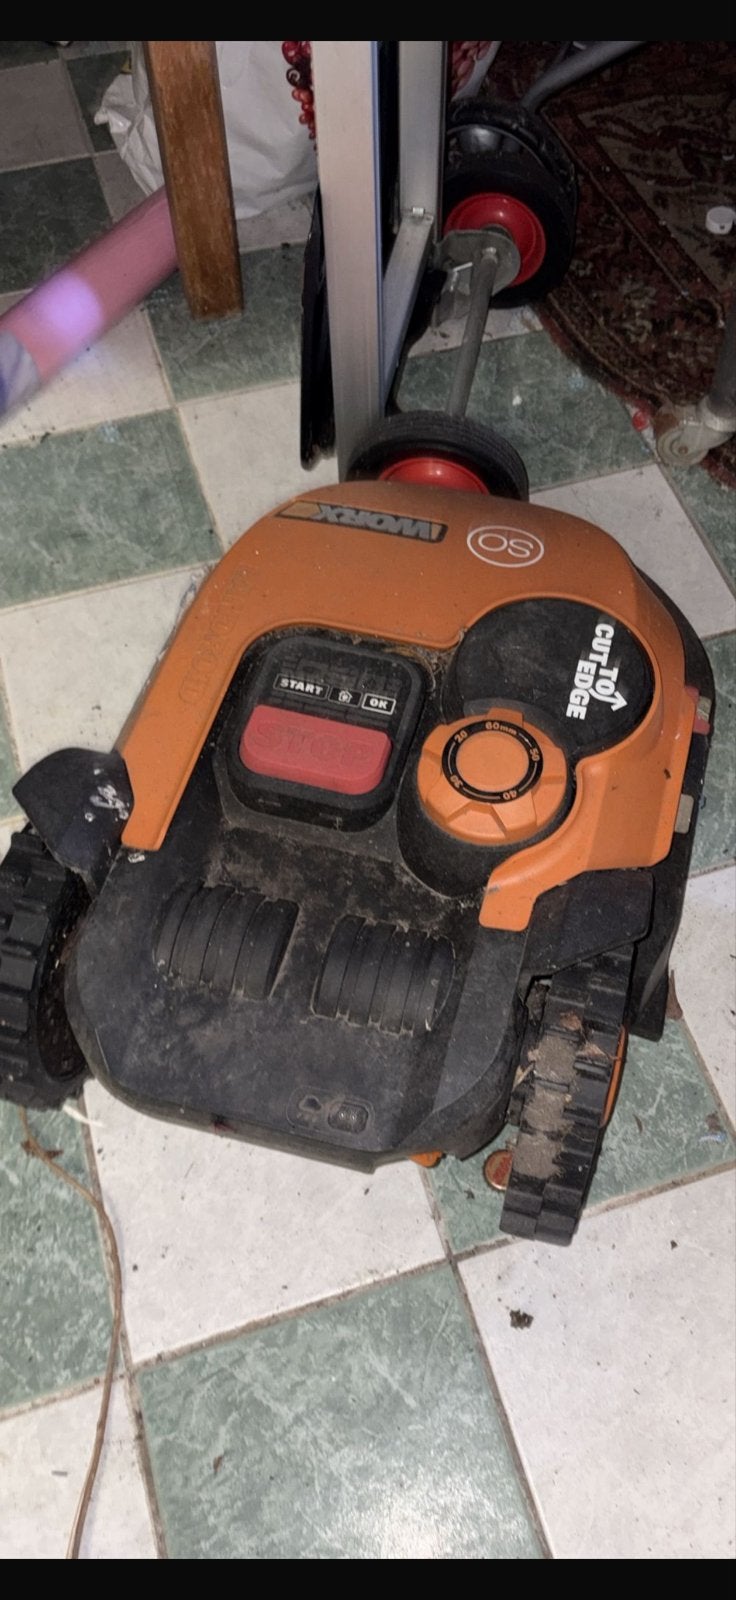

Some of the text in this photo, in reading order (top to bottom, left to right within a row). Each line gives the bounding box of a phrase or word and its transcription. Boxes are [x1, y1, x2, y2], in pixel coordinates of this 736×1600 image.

[310, 503, 432, 540] WORX
[589, 623, 615, 667] CUT
[279, 677, 324, 696] START
[566, 659, 598, 720] EDGE
[595, 666, 619, 696] TO
[369, 697, 388, 710] OK
[454, 730, 468, 743] 20
[485, 721, 517, 736] 60mm
[529, 748, 540, 762] 50
[502, 790, 517, 800] 40
